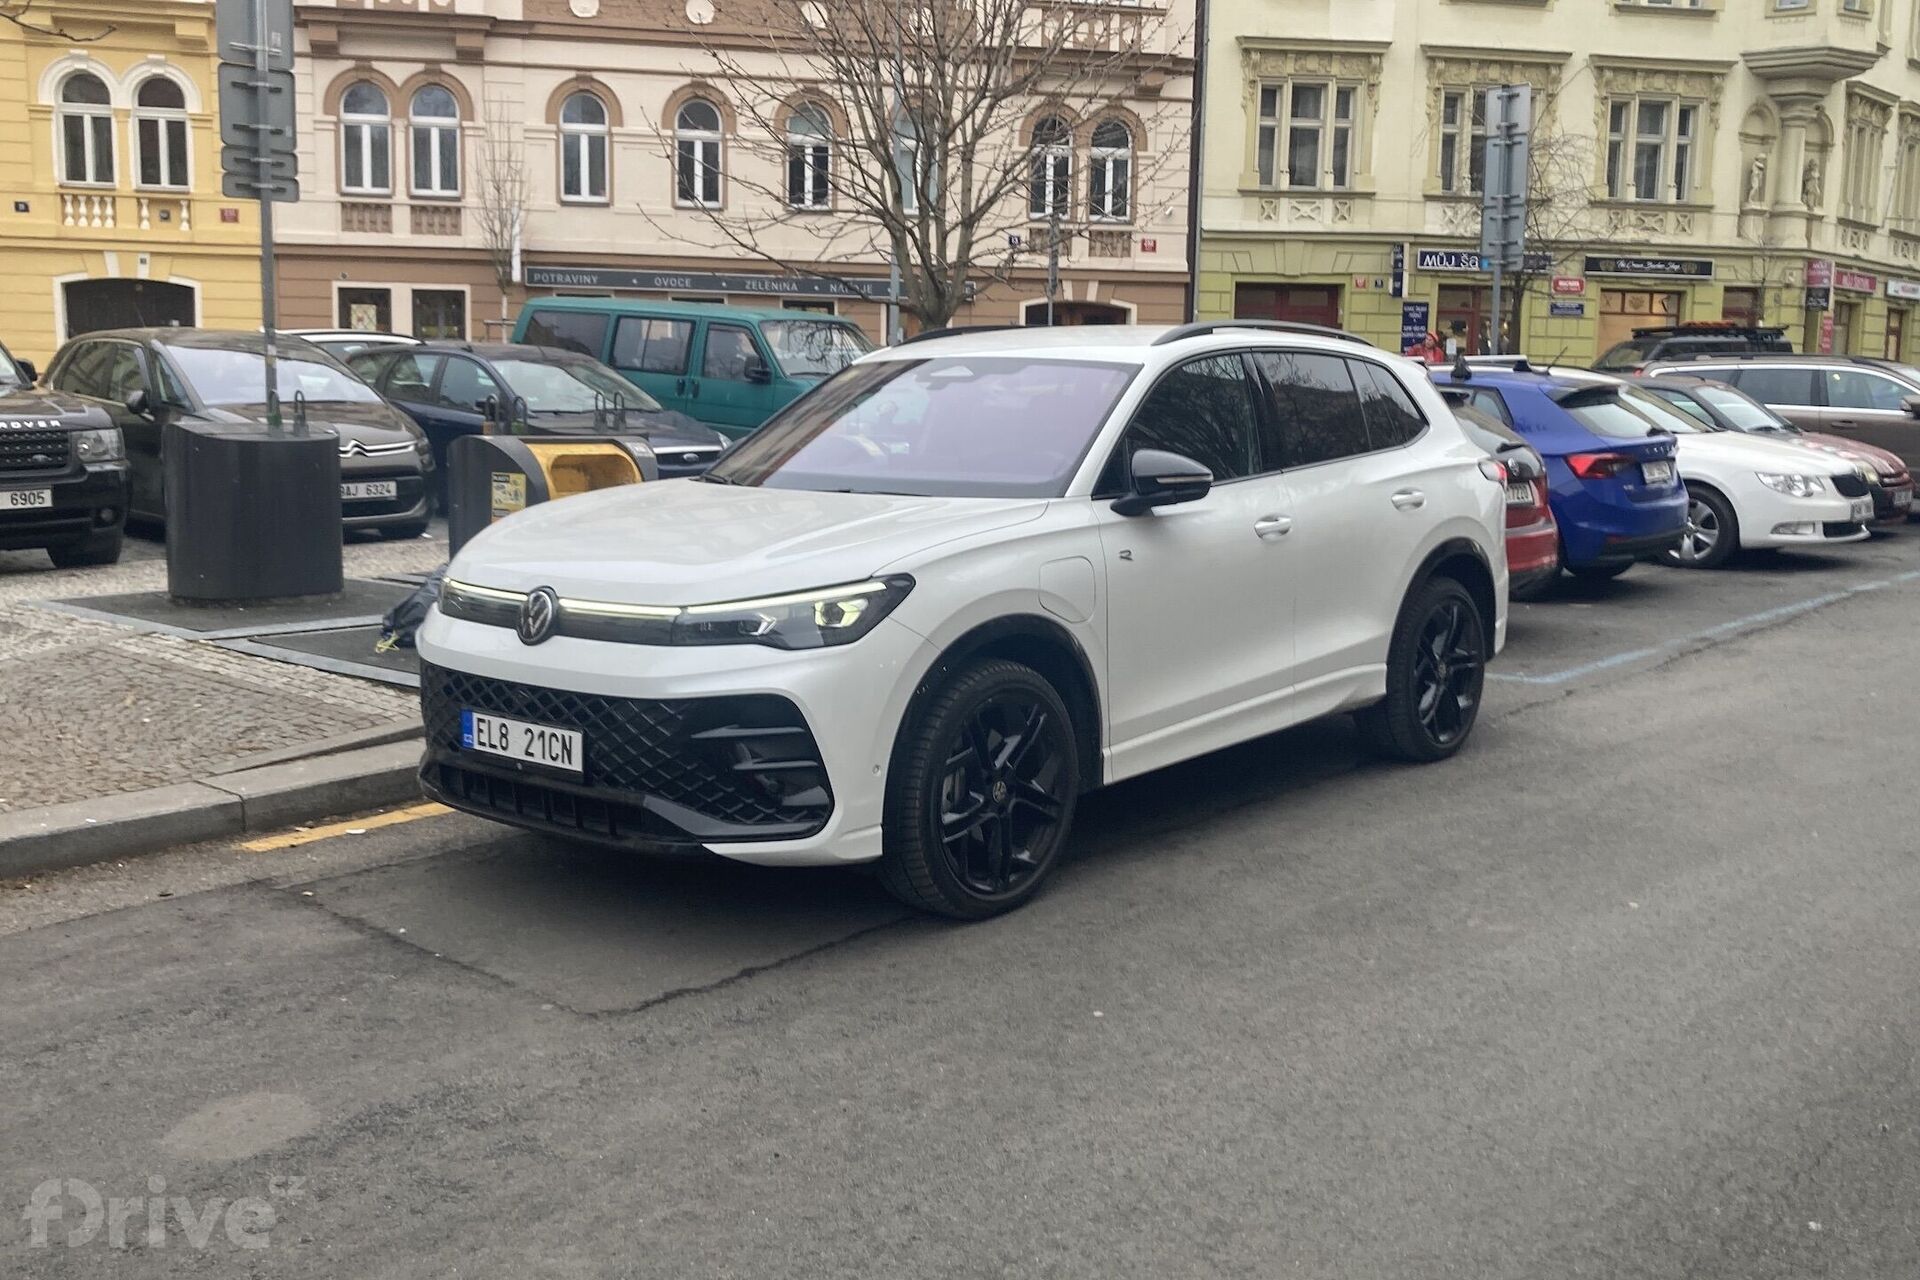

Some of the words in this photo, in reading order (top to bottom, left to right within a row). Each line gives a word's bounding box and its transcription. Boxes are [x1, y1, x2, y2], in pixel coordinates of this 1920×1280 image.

[533, 272, 599, 285] POTRAVINY
[654, 275, 692, 289] OVOCE
[744, 278, 799, 293] ZELENINA
[366, 482, 392, 496] 6324
[10, 491, 46, 506] 6905
[476, 717, 509, 751] EL8
[524, 727, 573, 766] 21CN
